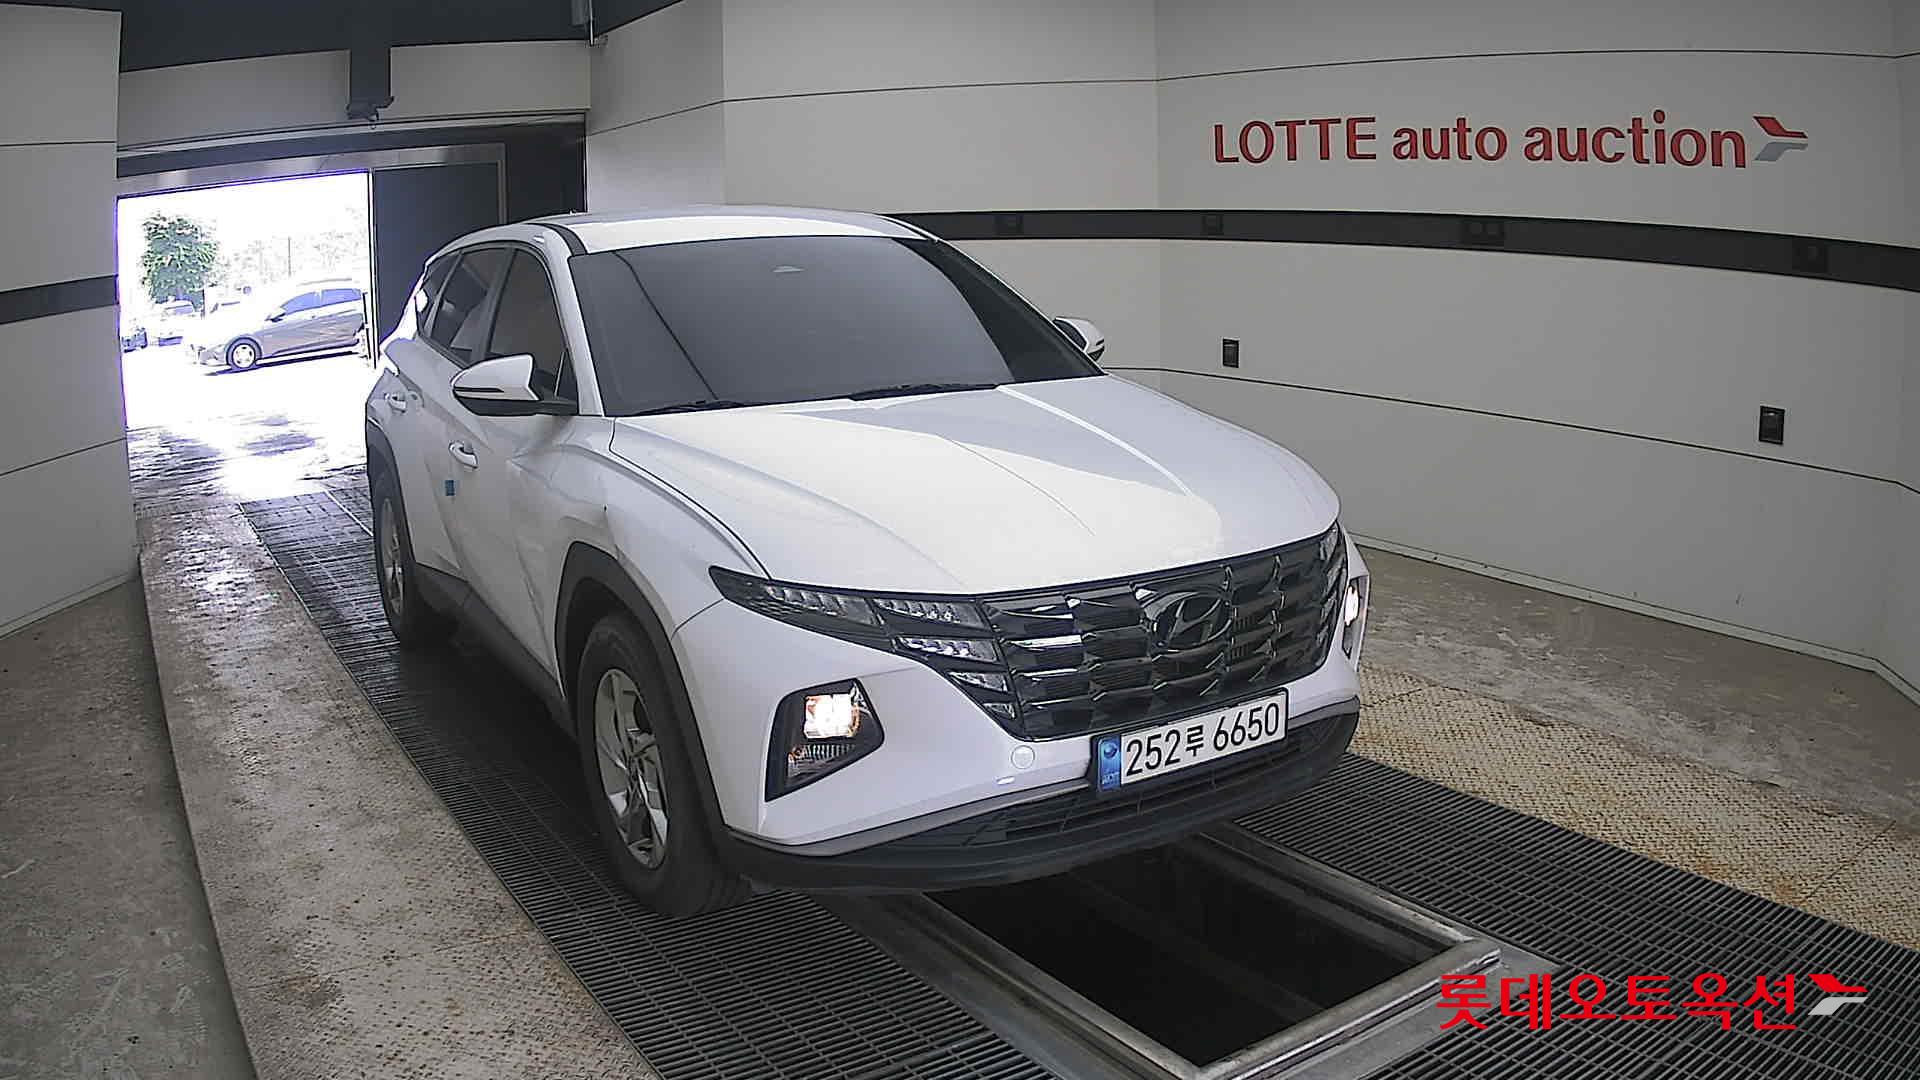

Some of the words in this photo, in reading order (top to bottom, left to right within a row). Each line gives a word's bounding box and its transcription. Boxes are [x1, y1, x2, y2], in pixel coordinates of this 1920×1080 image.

[1212, 116, 1377, 164] LOTTE
[1392, 116, 1508, 161] auto
[1523, 109, 1747, 169] auction
[1126, 724, 1204, 777] 252루
[1213, 702, 1280, 751] 6650
